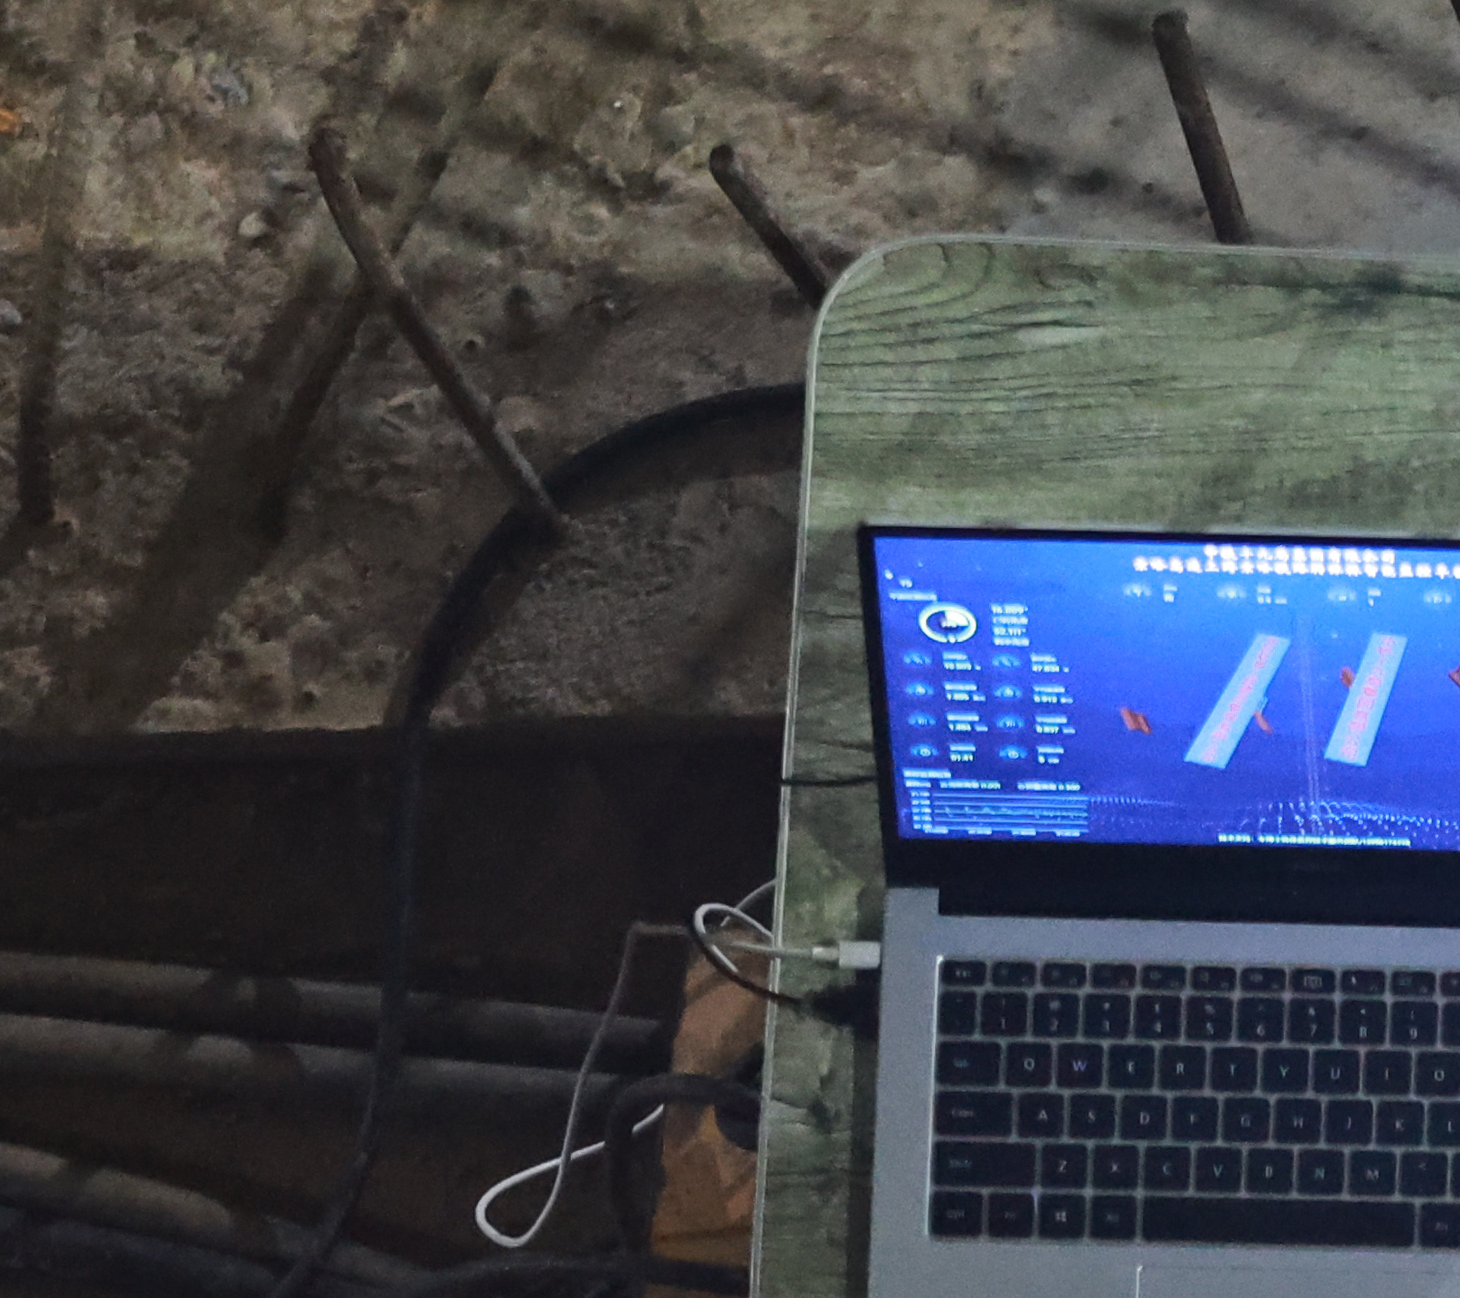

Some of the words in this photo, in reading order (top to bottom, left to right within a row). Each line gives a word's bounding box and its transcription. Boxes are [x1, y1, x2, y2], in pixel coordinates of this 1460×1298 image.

[1256, 1025, 1265, 1036] 6
[1409, 1028, 1418, 1038] 9
[1024, 1058, 1035, 1071] Q
[1073, 1060, 1086, 1071] W
[1228, 1064, 1237, 1076] T
[1331, 1068, 1340, 1079] U
[1434, 1070, 1444, 1081] O
[1039, 1110, 1048, 1120] A
[1087, 1111, 1096, 1122] S
[1140, 1112, 1149, 1124] D
[1394, 1118, 1404, 1130] K
[1110, 1161, 1119, 1173] X
[1161, 1164, 1170, 1174] C
[1315, 1168, 1324, 1179] N
[1367, 1169, 1379, 1179] M
